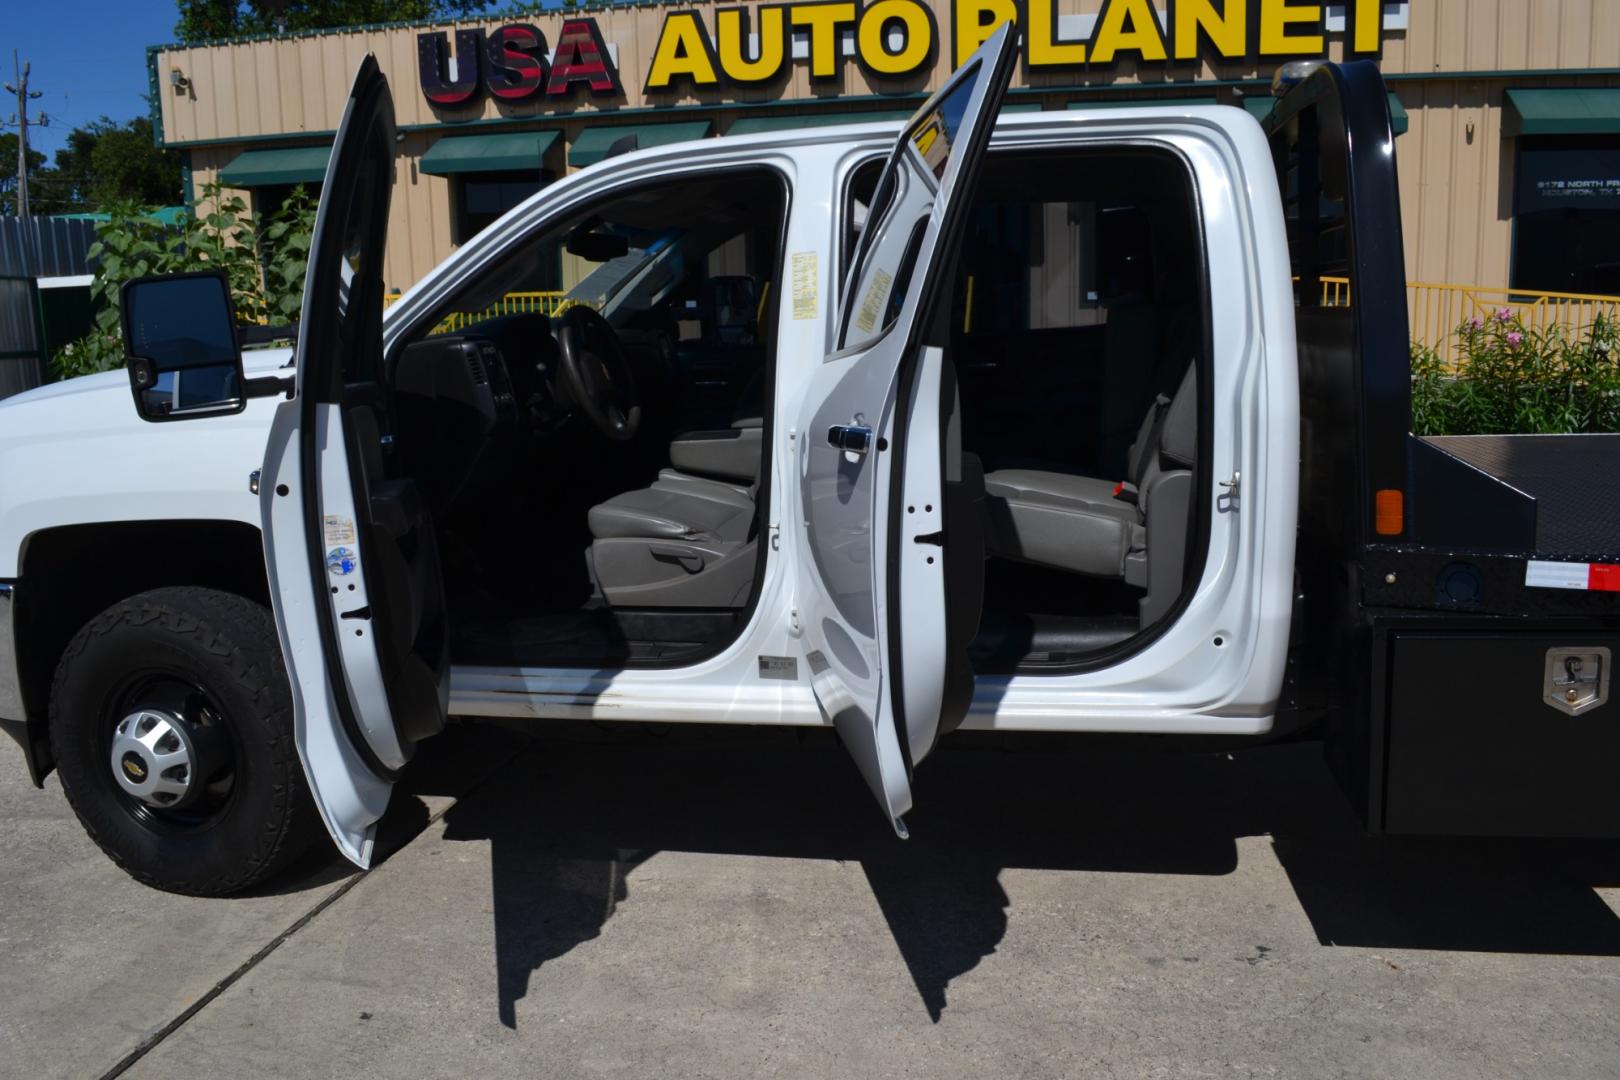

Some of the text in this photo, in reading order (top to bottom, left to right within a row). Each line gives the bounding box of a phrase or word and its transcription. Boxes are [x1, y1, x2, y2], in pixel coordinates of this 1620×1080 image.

[416, 19, 616, 105] USA
[646, 0, 935, 88] AUTO
[1567, 180, 1604, 188] NORTH
